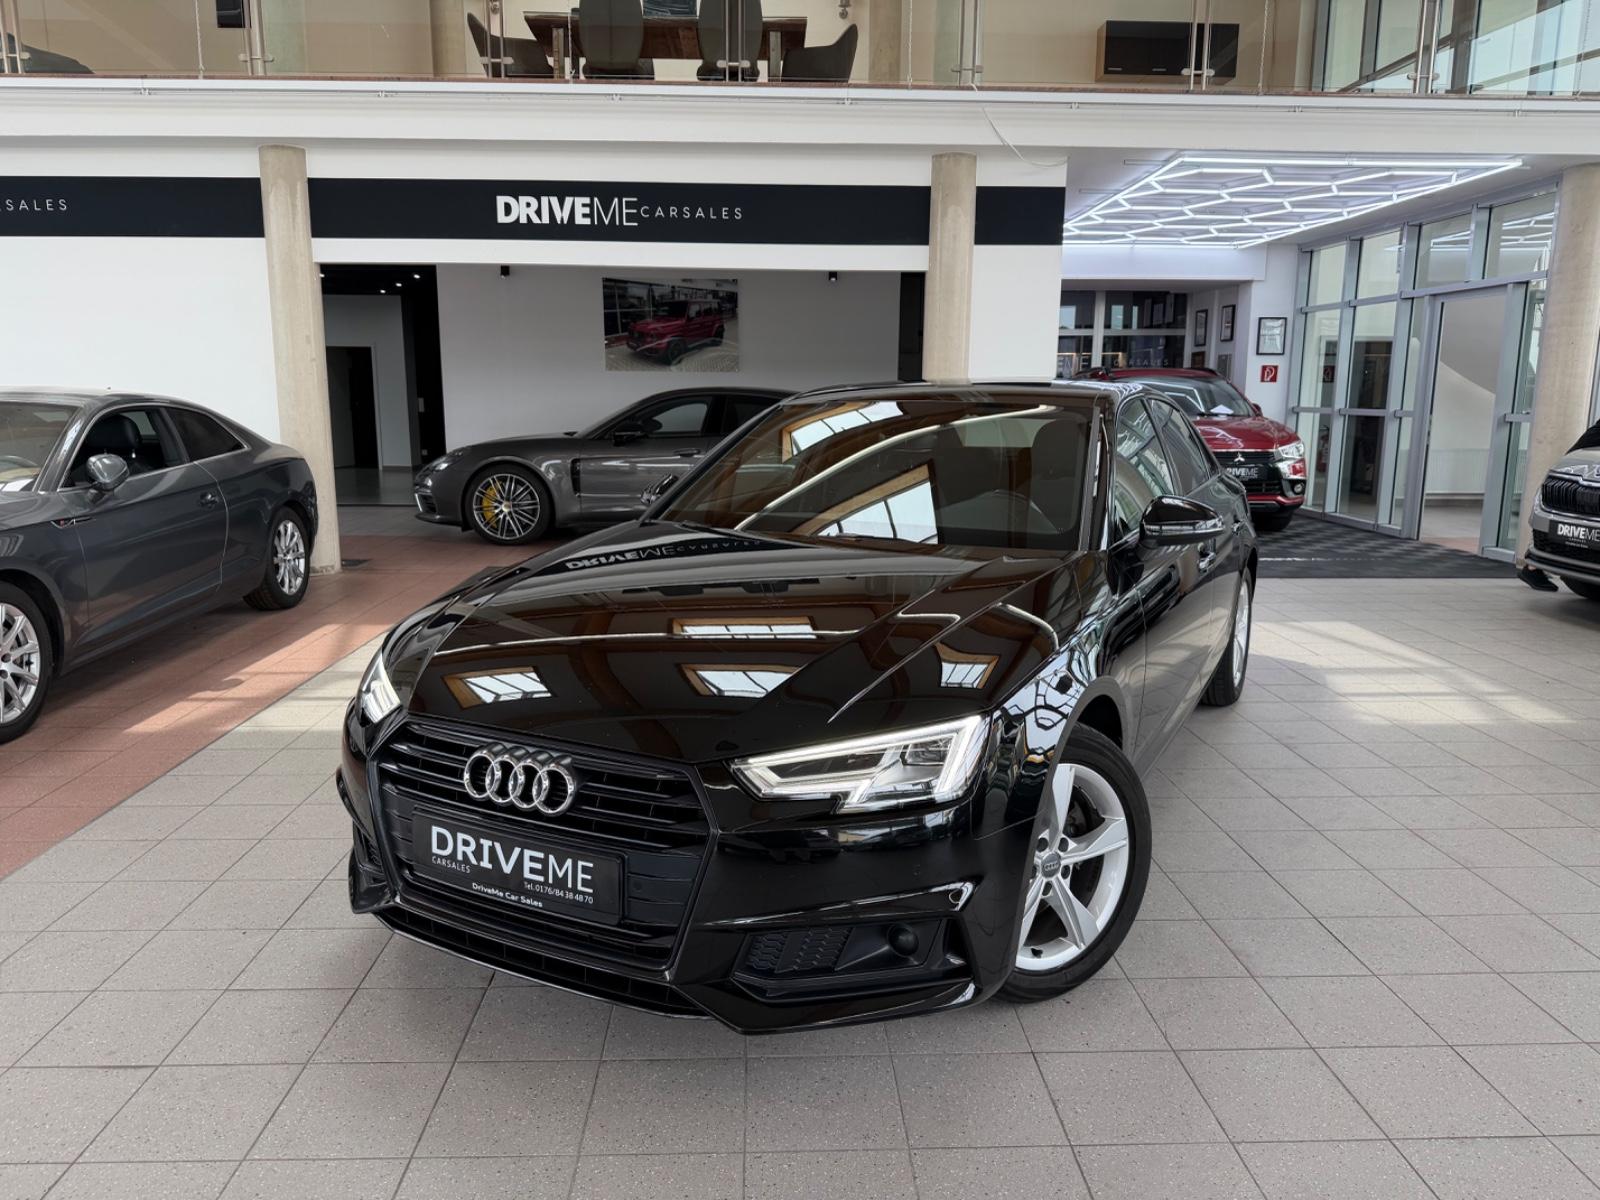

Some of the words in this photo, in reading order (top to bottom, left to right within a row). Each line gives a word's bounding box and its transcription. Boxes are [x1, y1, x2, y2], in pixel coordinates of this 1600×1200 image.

[0, 199, 67, 211] SALES
[496, 195, 638, 226] DRIVEME
[640, 205, 743, 220] CARSALES
[1557, 523, 1600, 542] DRIVEME
[431, 825, 594, 894] DRIVEME
[431, 855, 471, 874] CARSALES
[472, 882, 504, 897] DriveMe
[505, 892, 519, 901] Car
[520, 896, 543, 908] Sales
